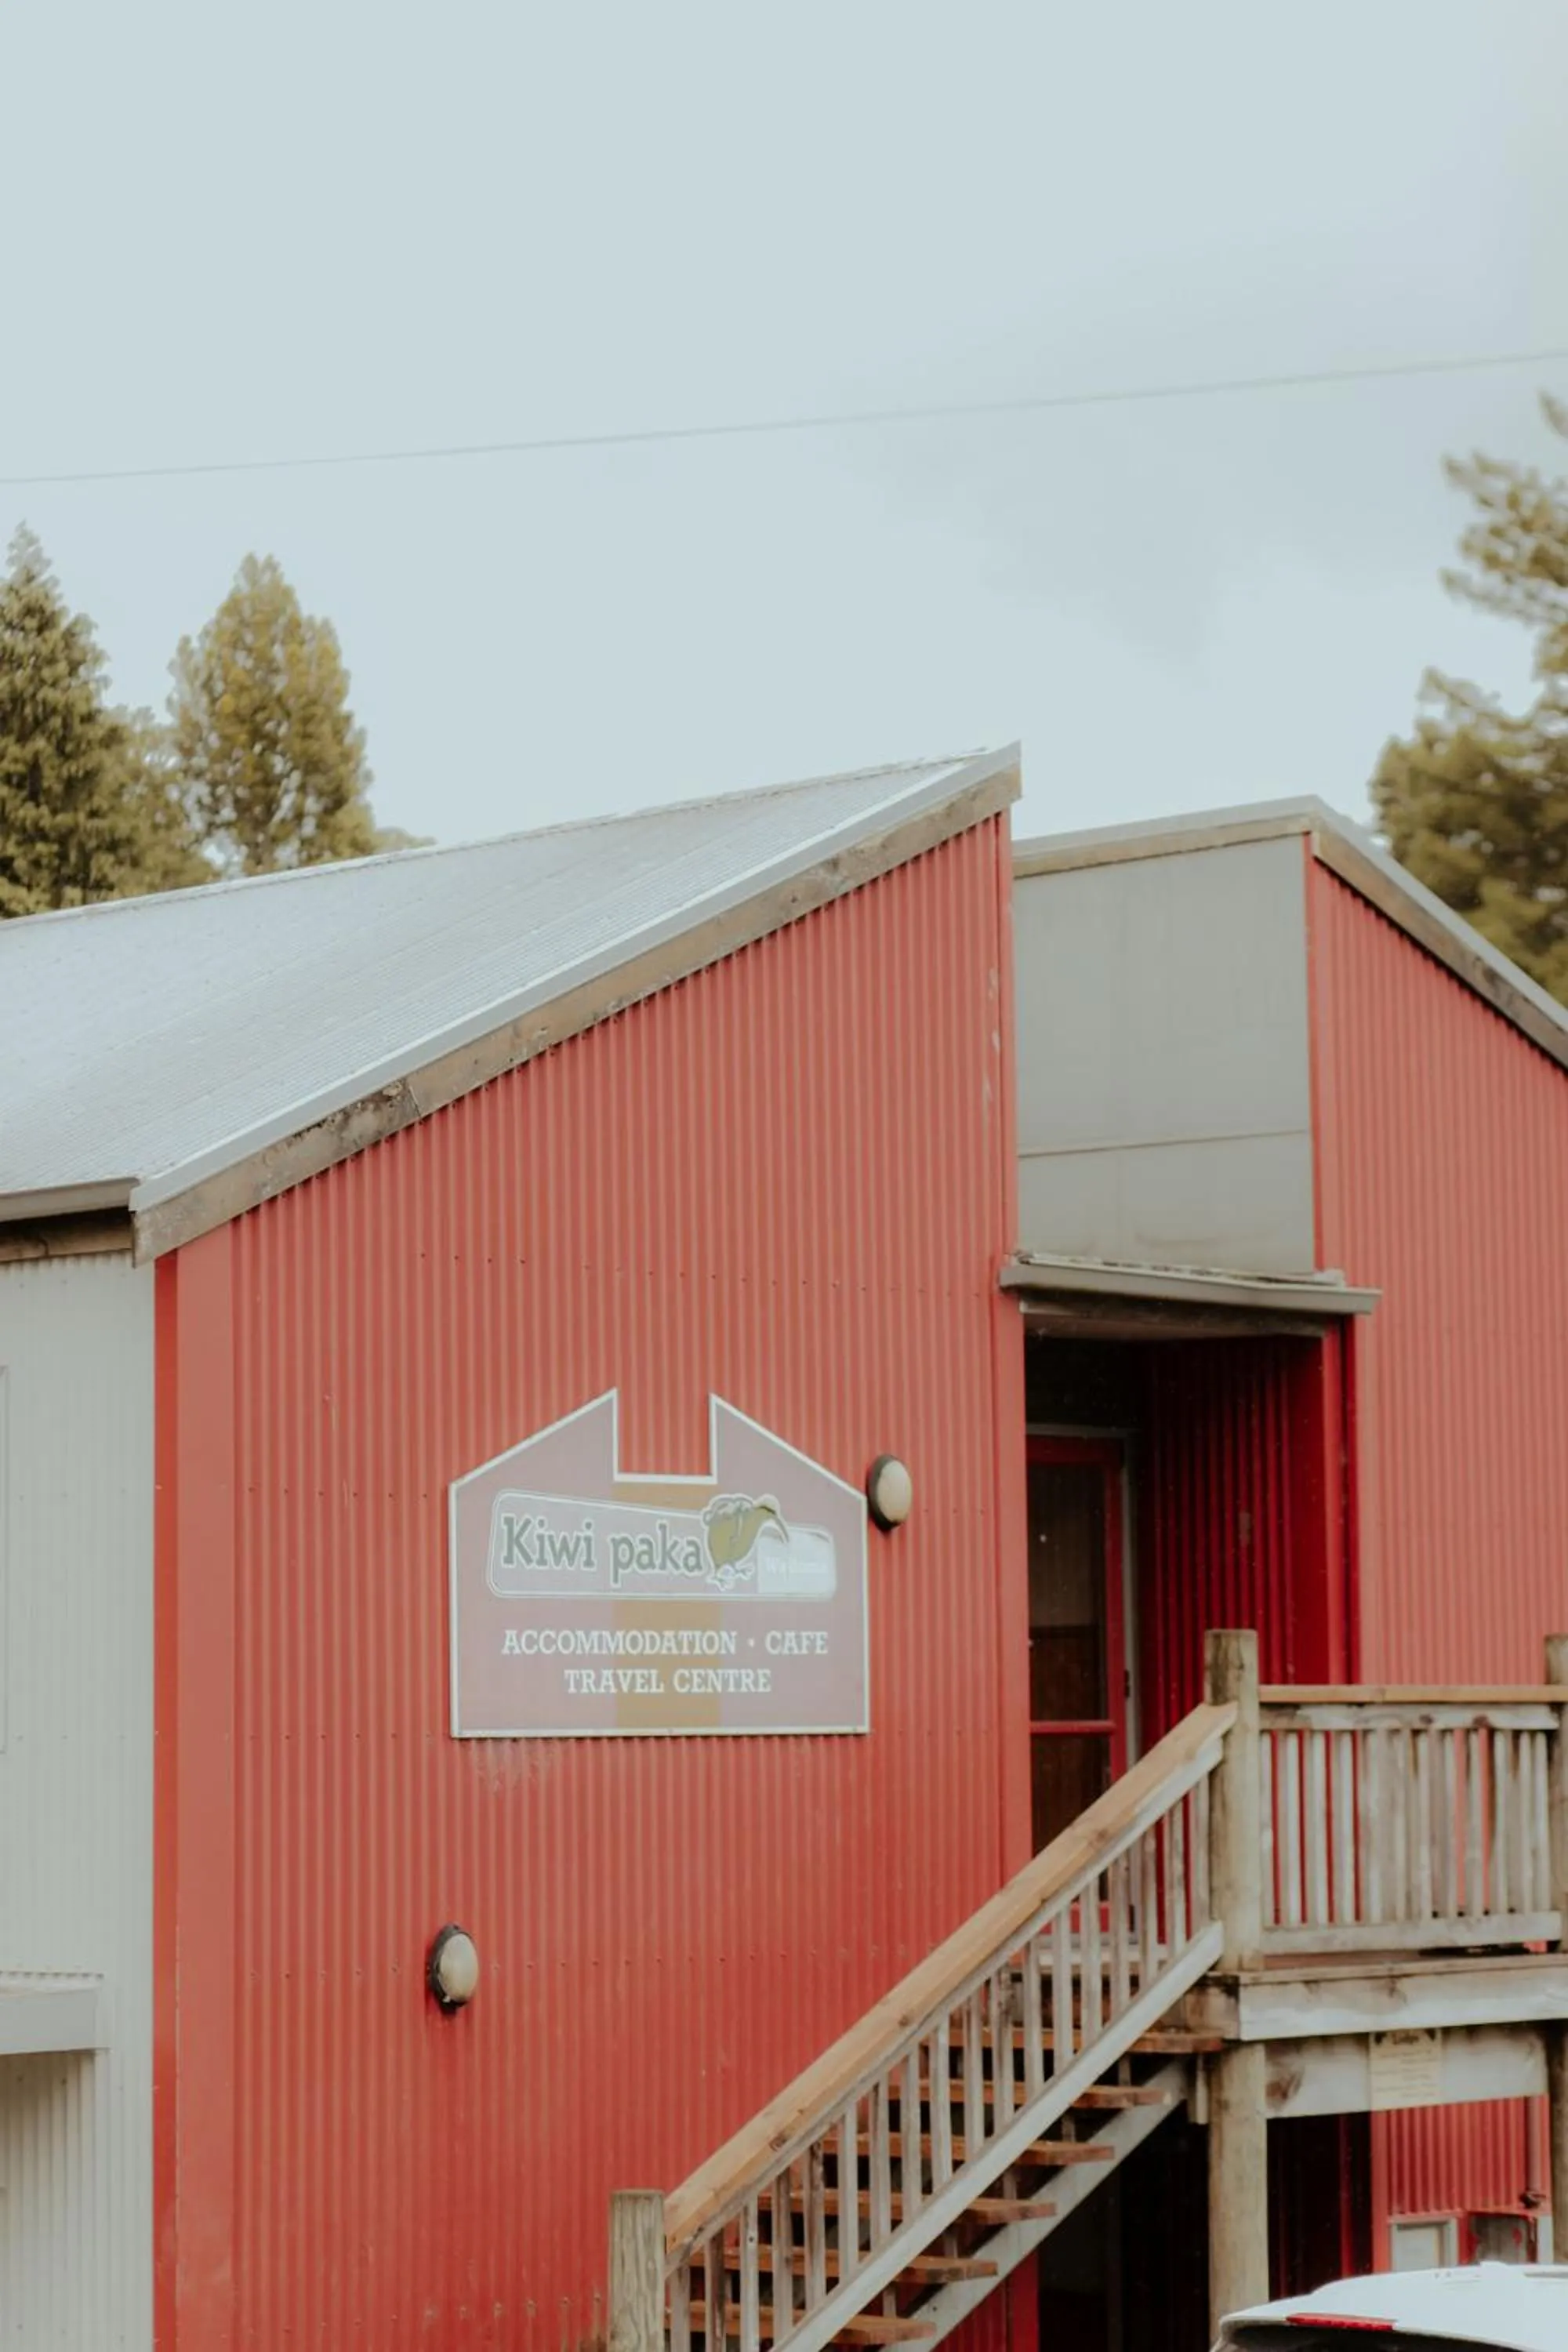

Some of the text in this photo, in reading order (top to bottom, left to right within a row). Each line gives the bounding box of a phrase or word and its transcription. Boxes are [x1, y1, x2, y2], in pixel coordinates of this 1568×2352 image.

[502, 1515, 704, 1585] Kiwi paka
[501, 1630, 829, 1655] ACCOMMODATION CAFE
[564, 1668, 771, 1693] TRAVEL CENTRE
